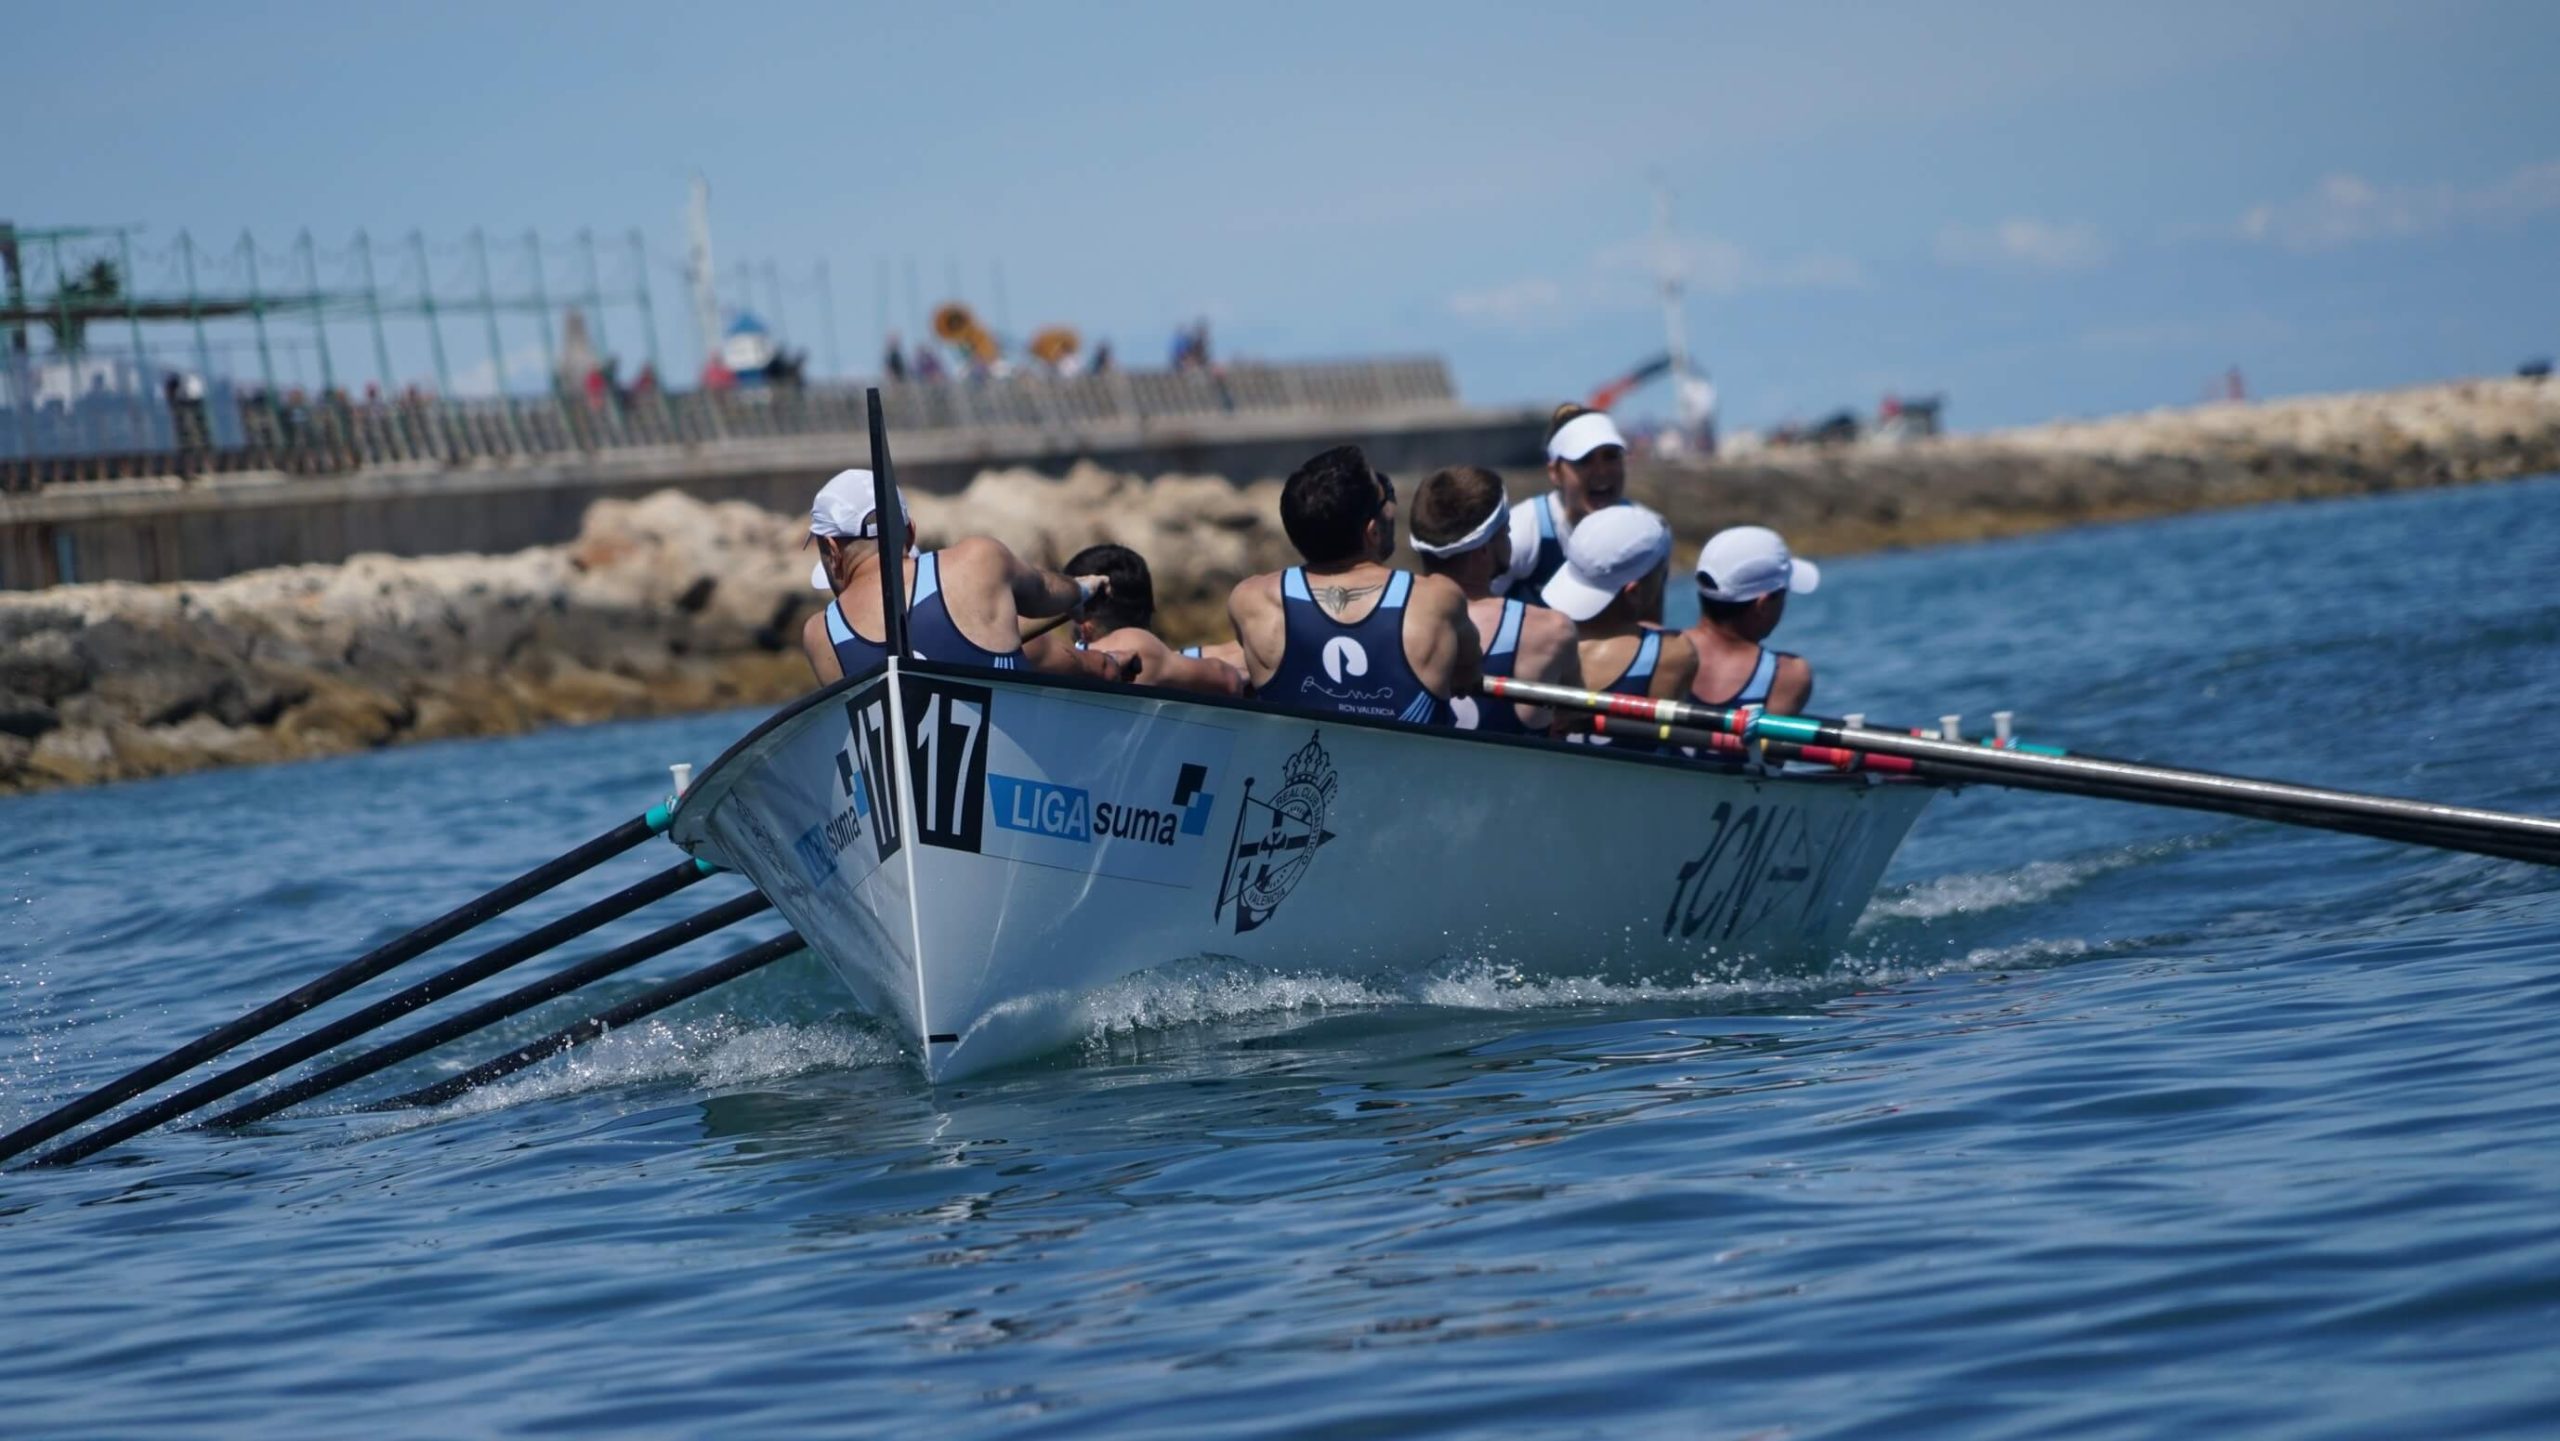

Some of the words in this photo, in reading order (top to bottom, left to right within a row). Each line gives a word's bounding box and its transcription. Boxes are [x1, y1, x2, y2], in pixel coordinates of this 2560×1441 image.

[857, 699, 896, 846] 17
[916, 692, 983, 836] 17
[1011, 784, 1087, 838] LIGA
[1093, 802, 1178, 847] suma
[825, 805, 862, 856] suma
